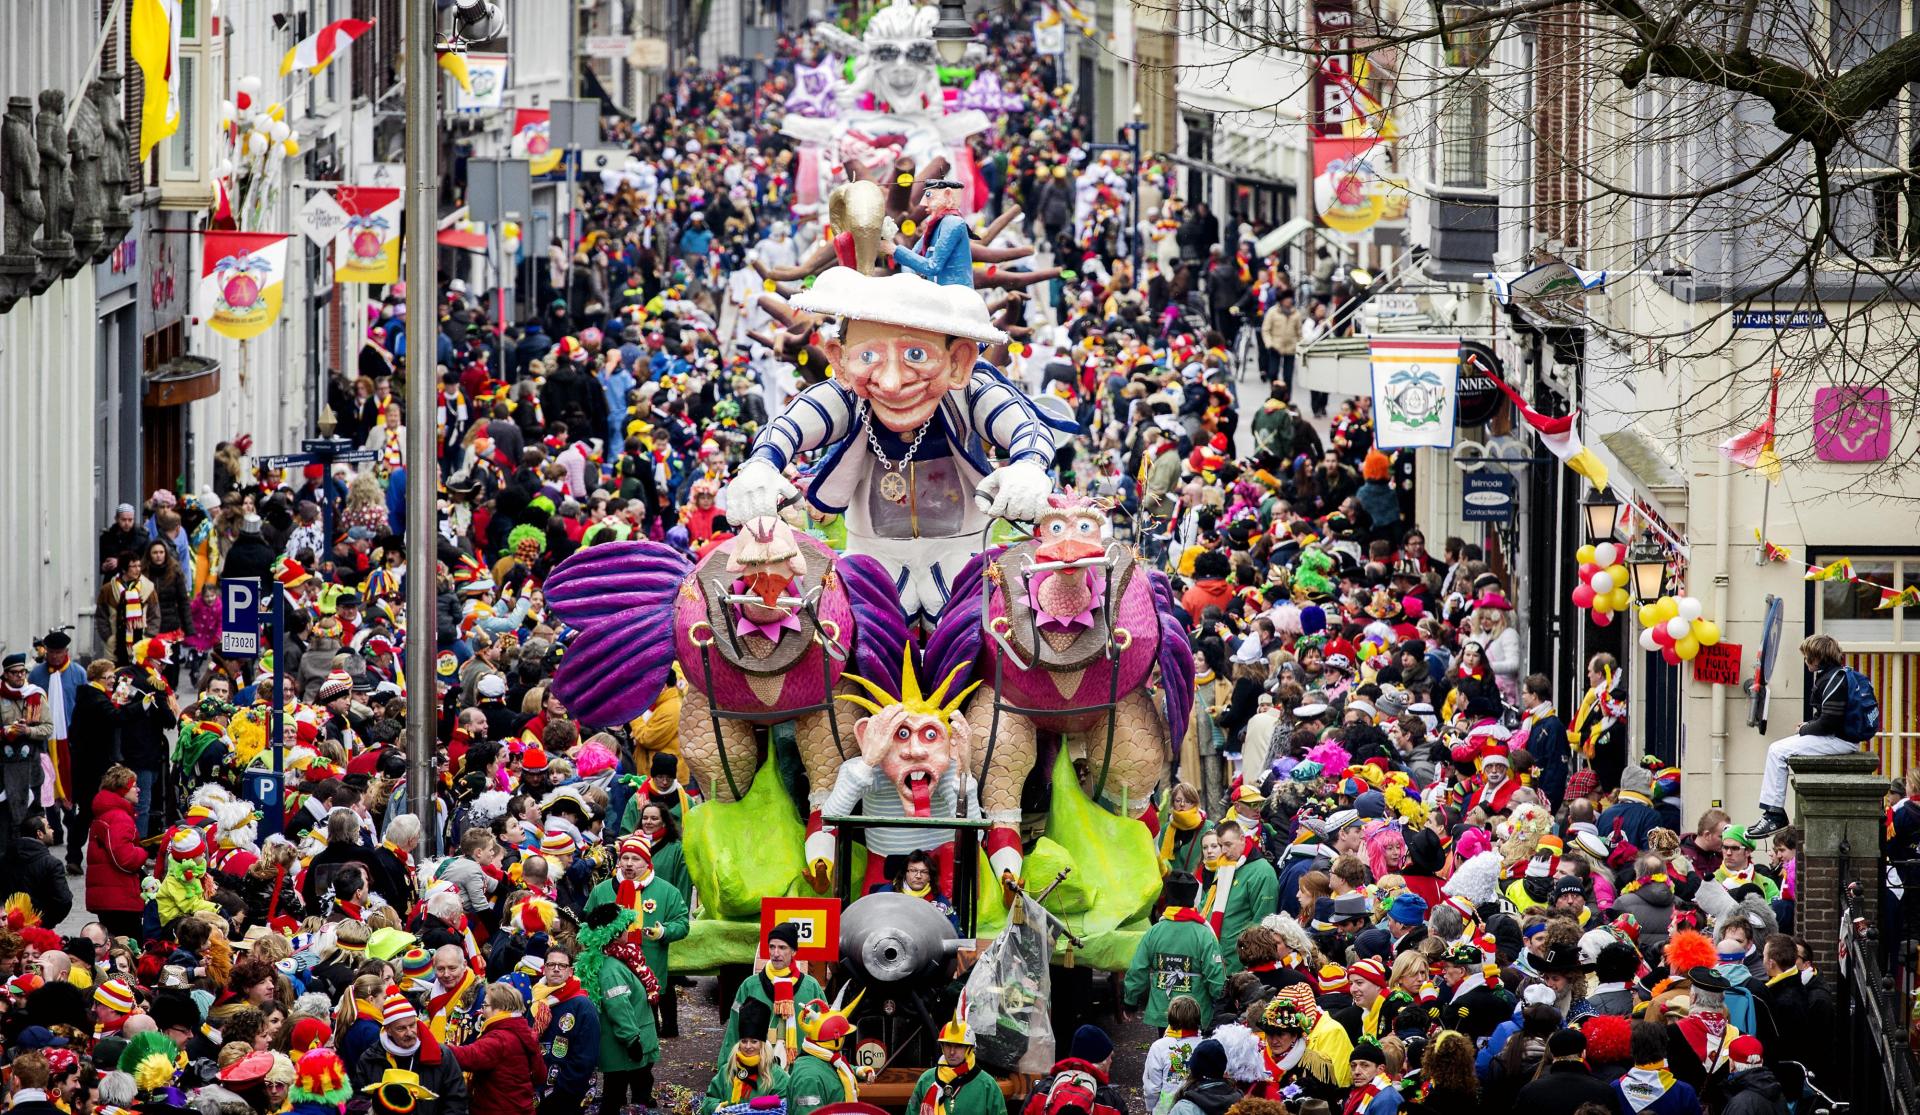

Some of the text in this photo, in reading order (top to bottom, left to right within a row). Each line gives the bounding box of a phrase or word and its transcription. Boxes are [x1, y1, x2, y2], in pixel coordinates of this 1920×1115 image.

[1318, 11, 1352, 25] van
[1471, 480, 1503, 488] Brilmode
[229, 584, 253, 623] P
[231, 637, 254, 649] 73020
[260, 778, 274, 800] P
